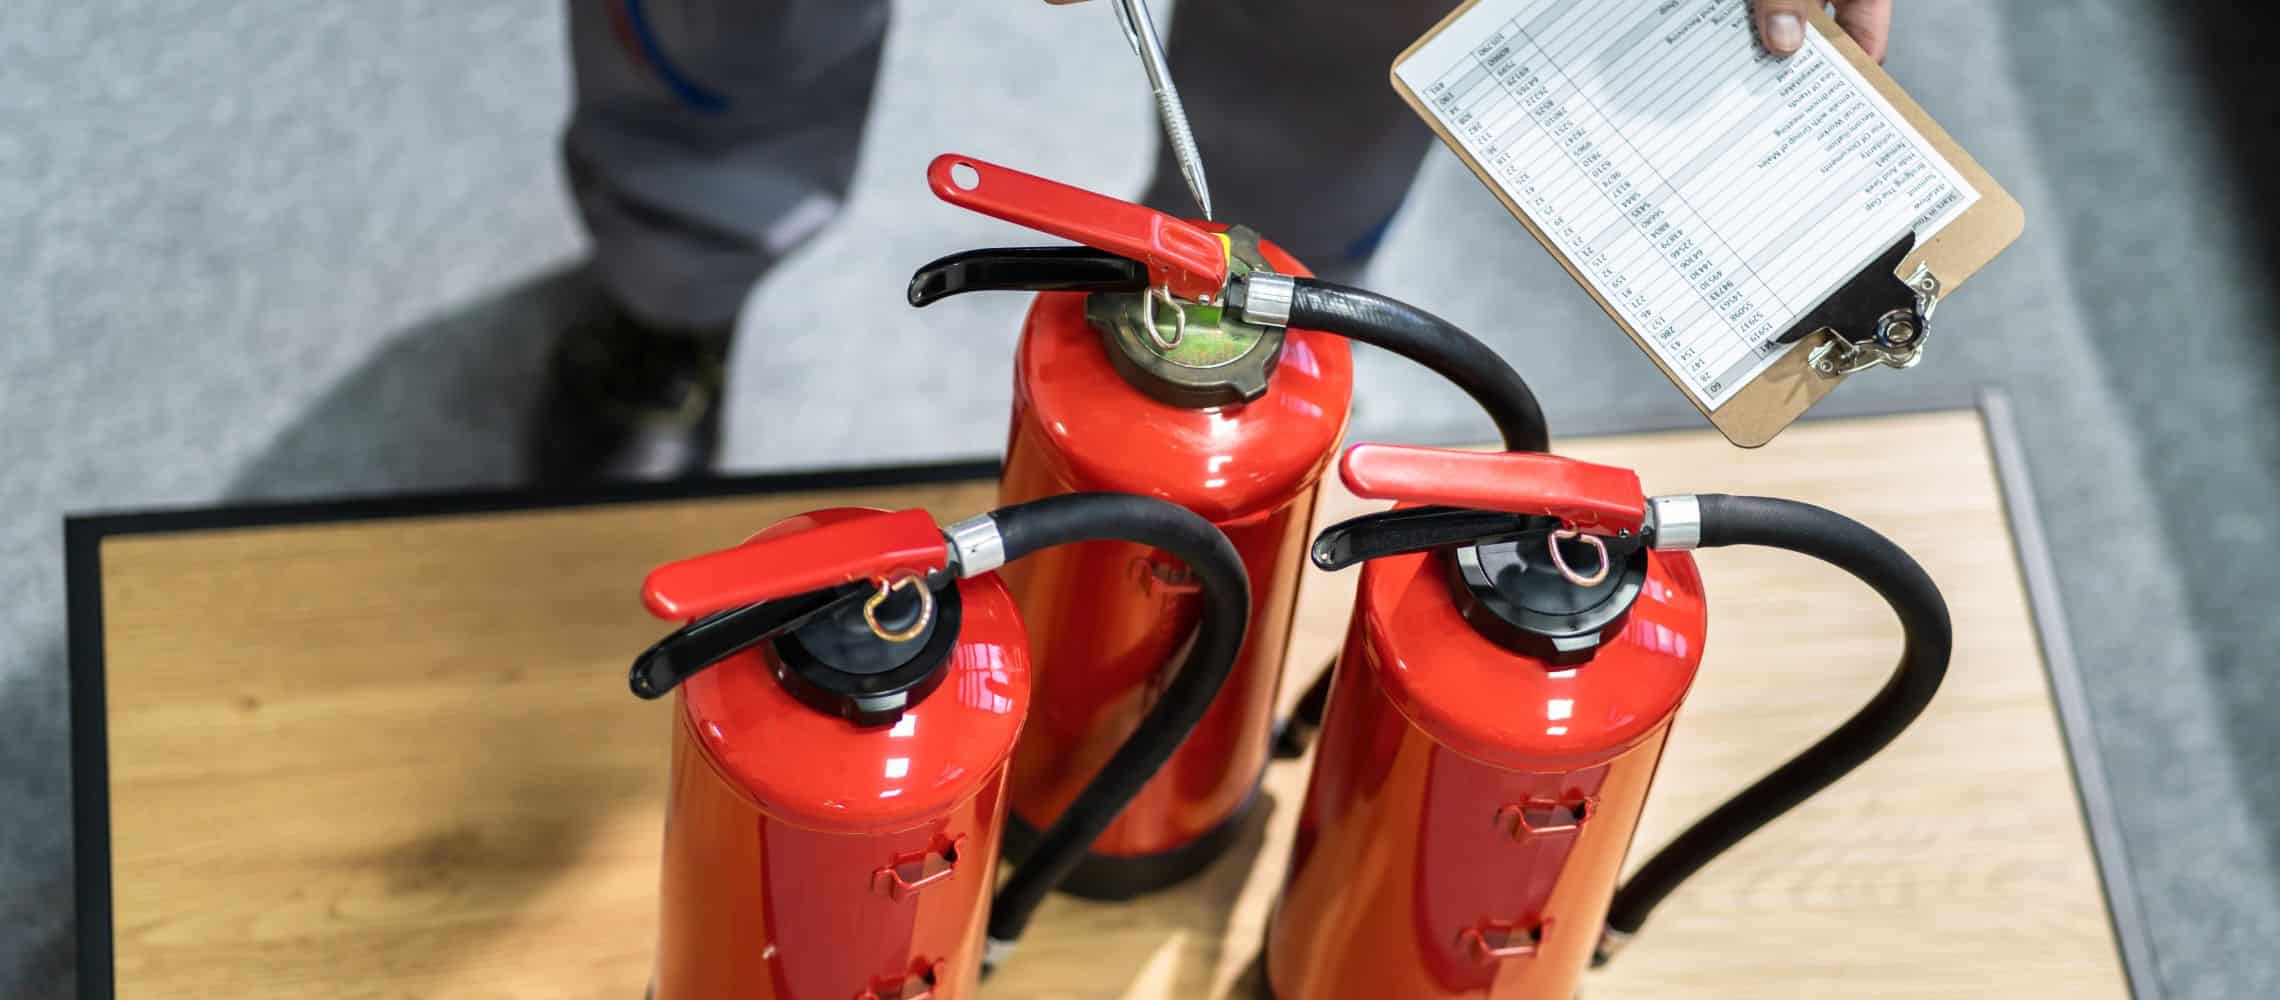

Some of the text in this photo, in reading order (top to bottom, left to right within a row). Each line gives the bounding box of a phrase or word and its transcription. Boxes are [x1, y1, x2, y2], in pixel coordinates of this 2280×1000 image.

[1699, 4, 1716, 19] And
[1664, 15, 1702, 45] Receiving
[1788, 48, 1814, 68] green
[1778, 59, 1824, 97] sweepstakes
[1786, 70, 1835, 109] Sea Of Hands
[1772, 79, 1846, 137] boardroom meeting
[1815, 101, 1865, 142] Social Worker
[1757, 90, 1855, 170] Female with Group of Males
[1819, 120, 1886, 174] Pile Of Documents
[1859, 131, 1896, 160] Solidarity
[1874, 141, 1906, 167] female1
[1591, 160, 1611, 177] 6210
[1864, 151, 1916, 194] Hide And Seek
[1862, 161, 1926, 211] Bridging The Gap
[1906, 172, 1937, 197] Summit
[1913, 182, 1946, 210] dataflow
[1935, 192, 1957, 210] Stars
